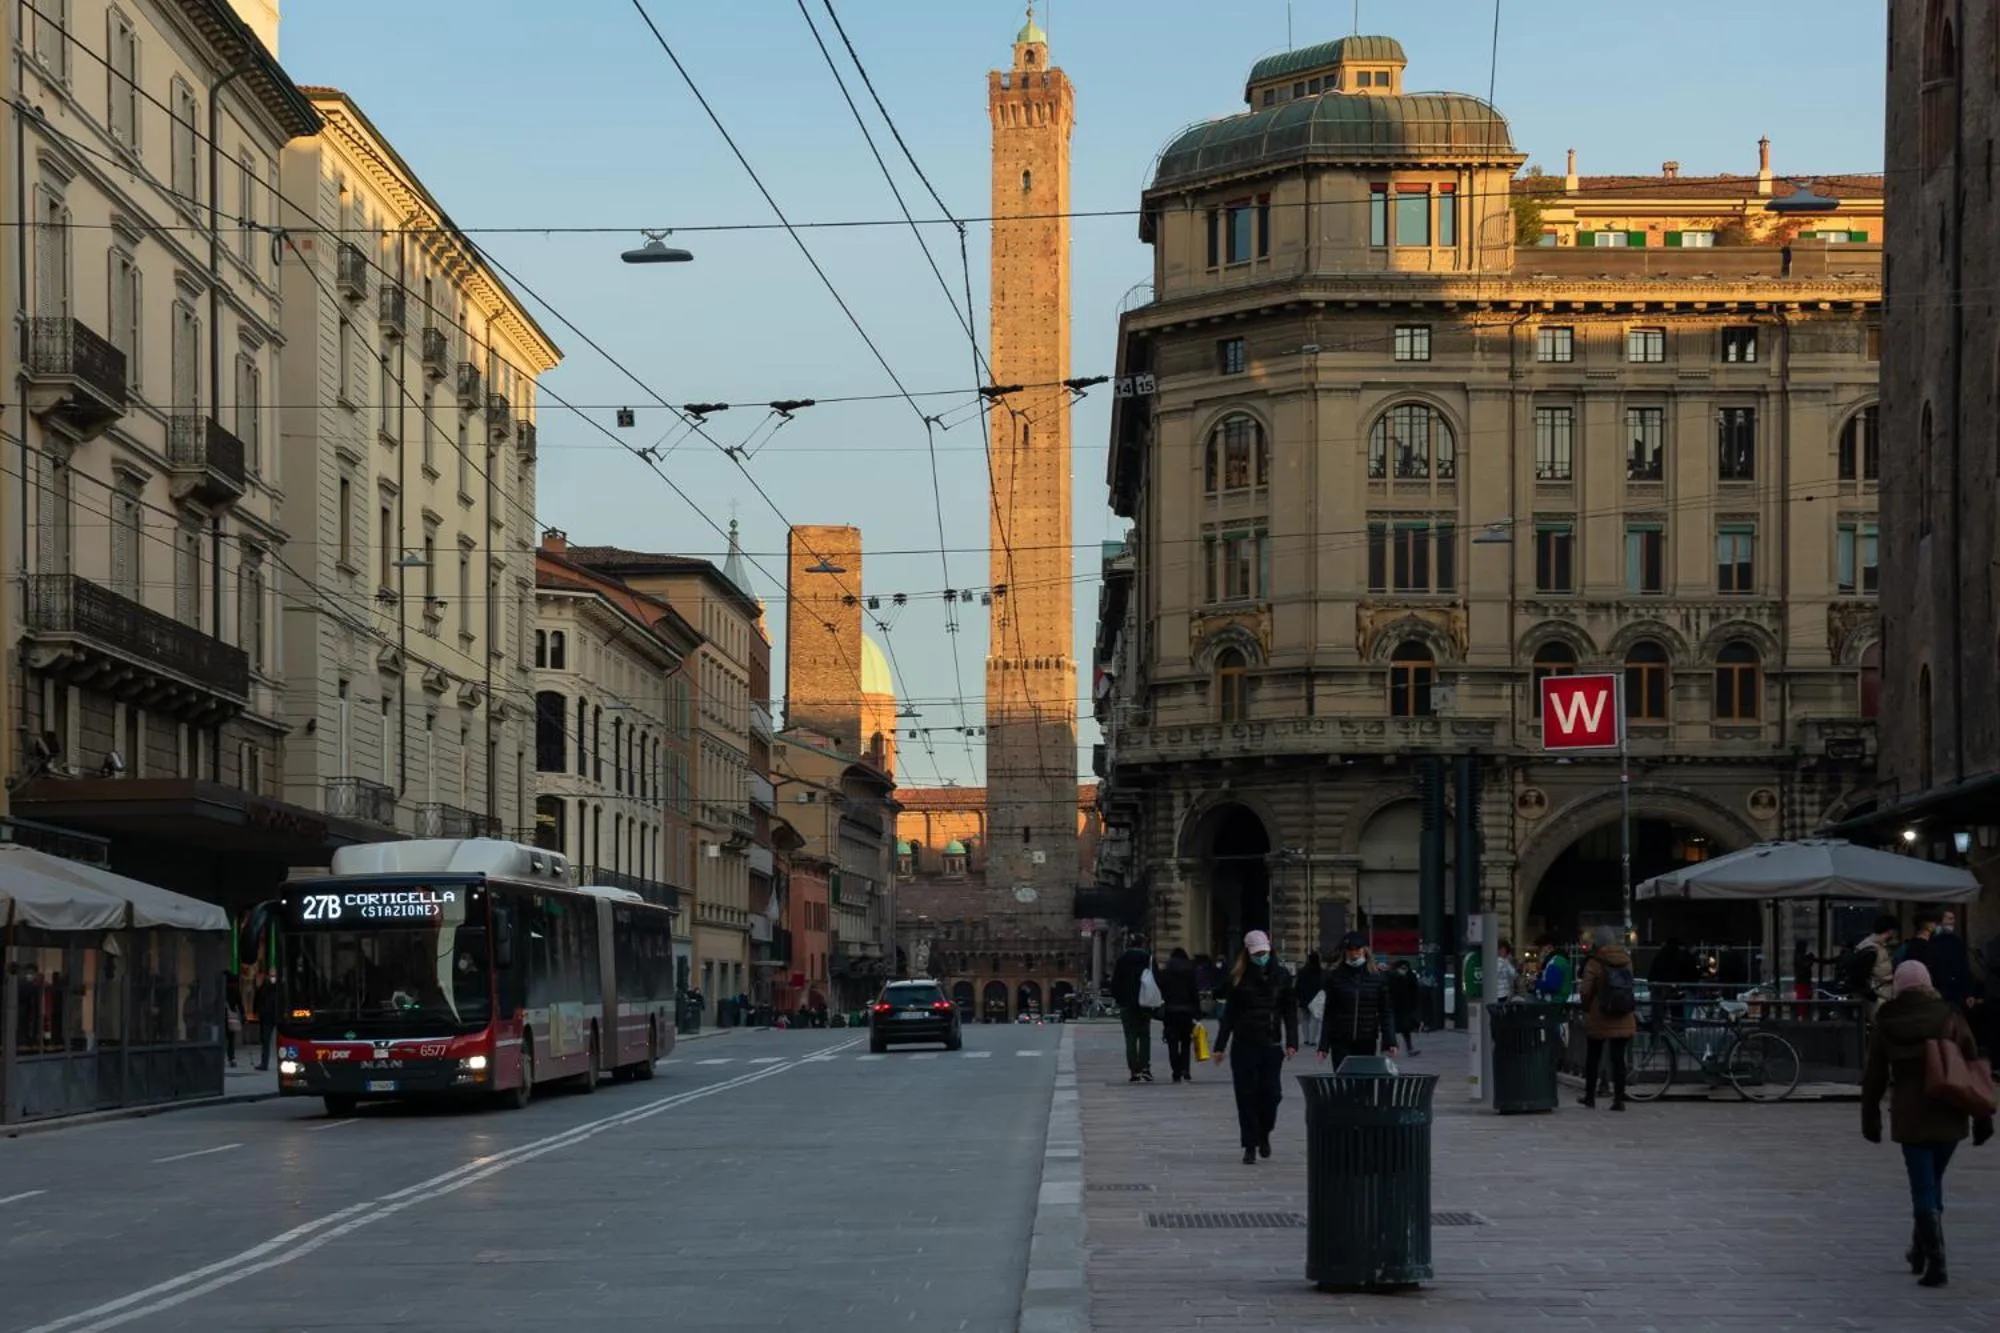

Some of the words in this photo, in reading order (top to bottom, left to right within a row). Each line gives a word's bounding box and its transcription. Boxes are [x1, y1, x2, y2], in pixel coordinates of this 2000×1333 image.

[1116, 383, 1131, 395] 14
[1138, 380, 1154, 392] 15
[1549, 690, 1608, 734] W
[303, 895, 342, 919] 27B
[344, 891, 456, 906] CORTICELLA
[361, 903, 440, 918] (STAZIONE)
[420, 1044, 447, 1057] 6577
[361, 1060, 403, 1069] MAN
